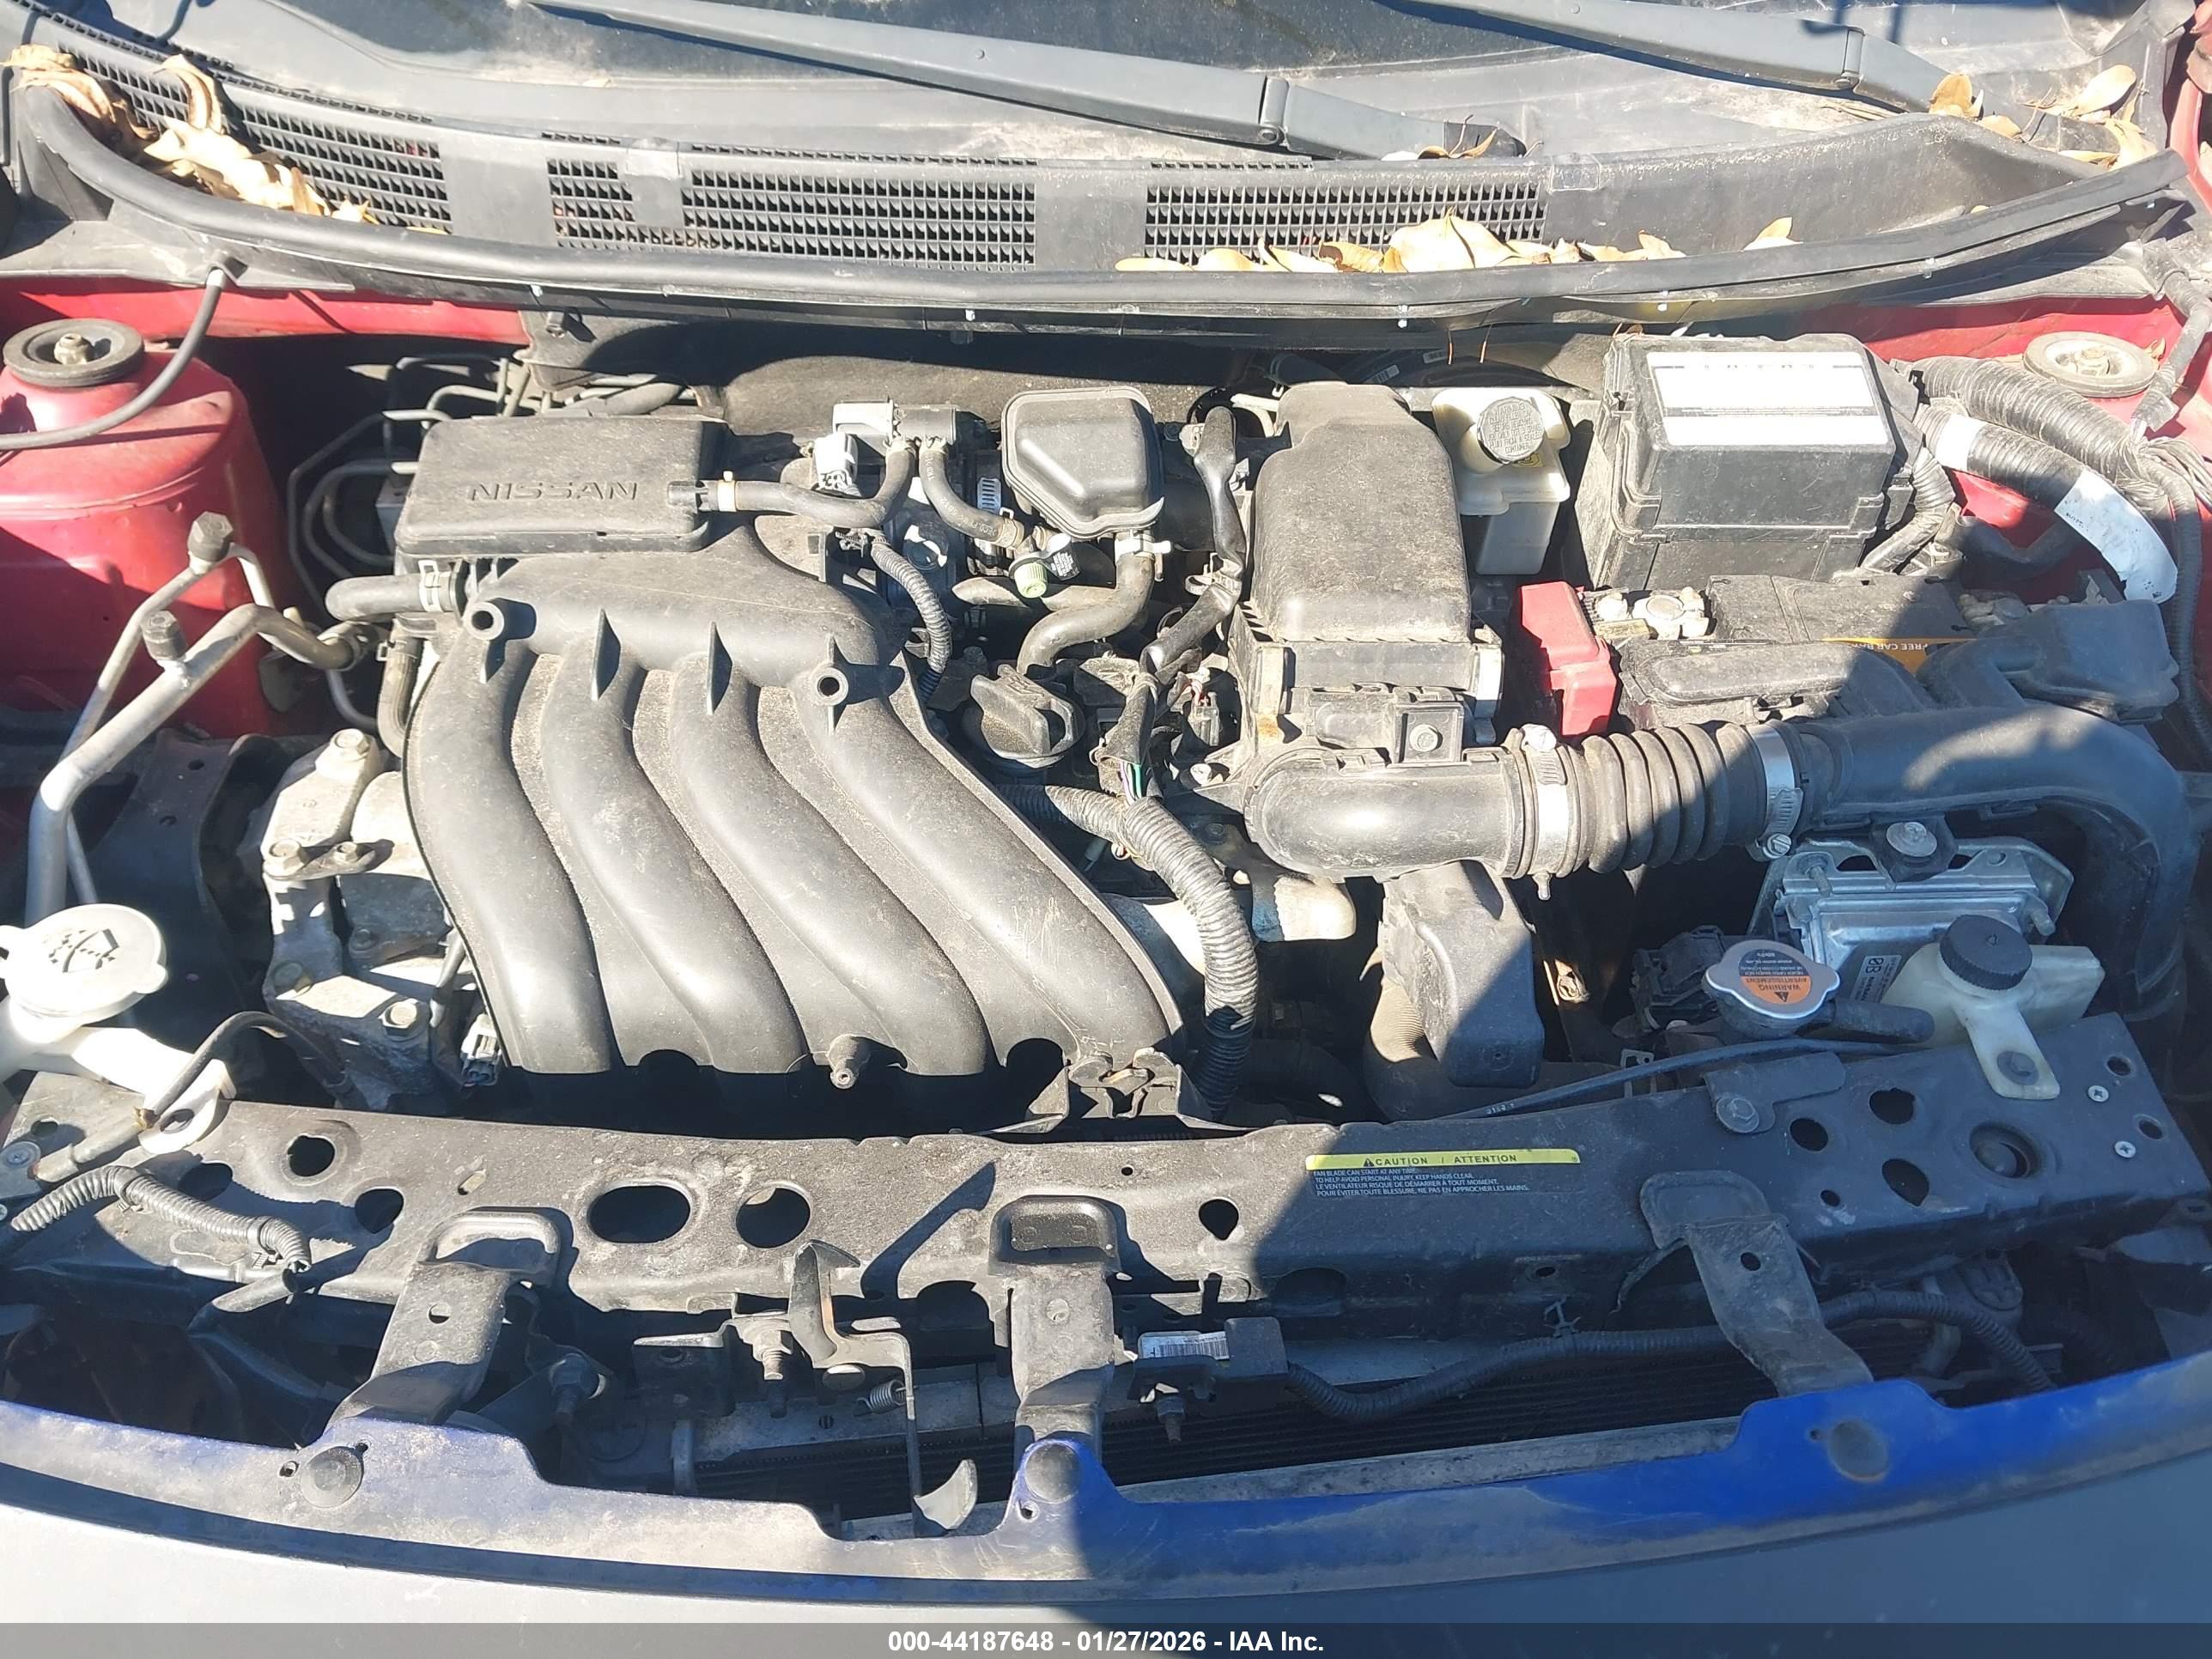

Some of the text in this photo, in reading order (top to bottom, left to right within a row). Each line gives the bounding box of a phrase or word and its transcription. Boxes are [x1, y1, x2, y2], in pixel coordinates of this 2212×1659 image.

[471, 482, 638, 501] NISSAN
[1376, 1157, 1428, 1166] CAUTION
[1453, 1154, 1517, 1164] ATTENTION
